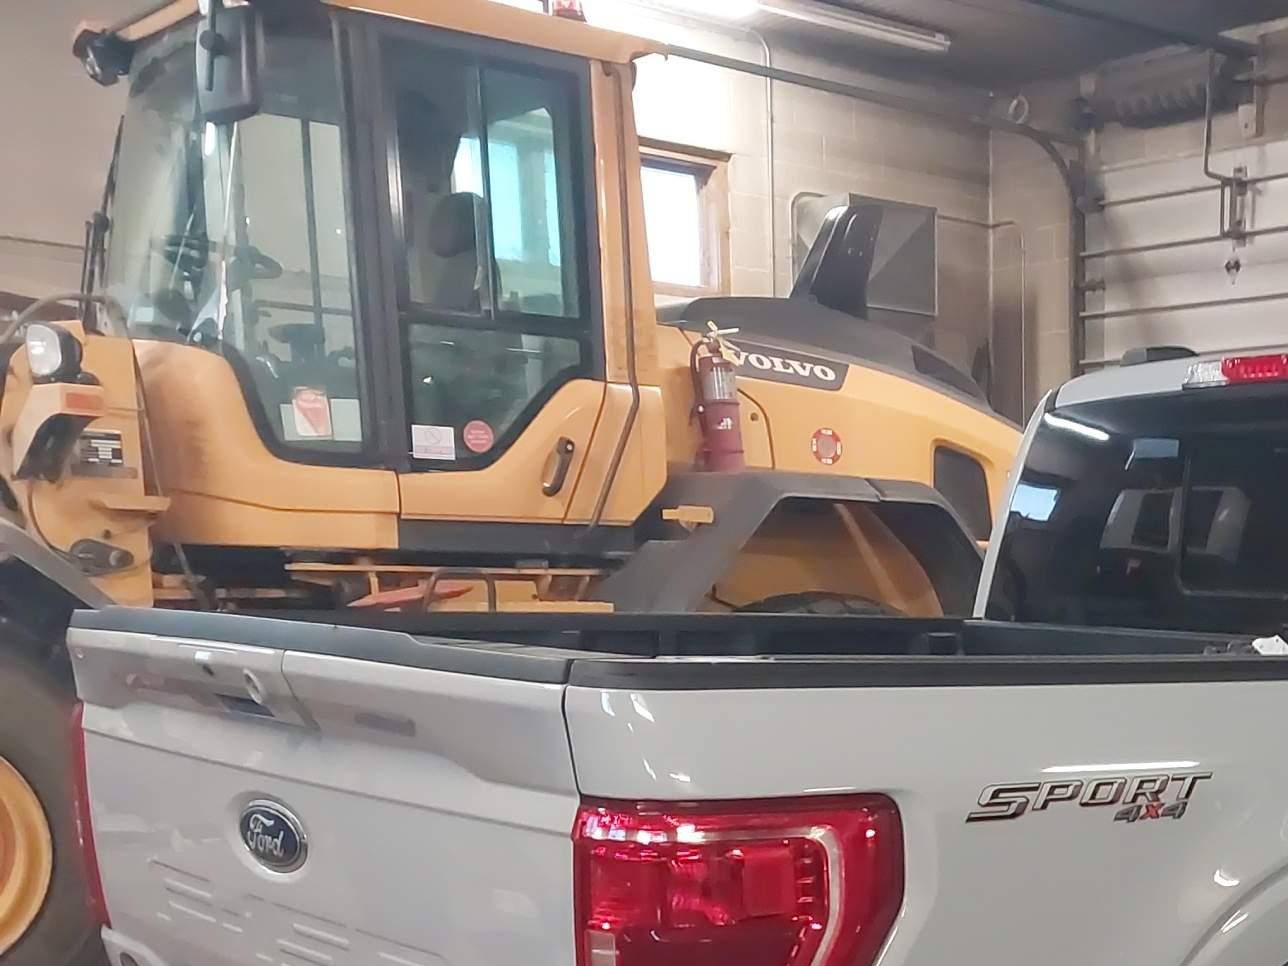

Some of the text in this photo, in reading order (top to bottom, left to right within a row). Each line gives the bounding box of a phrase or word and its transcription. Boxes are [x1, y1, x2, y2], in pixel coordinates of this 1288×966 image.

[730, 350, 836, 381] VOLVO
[965, 771, 1213, 824] SPORT
[247, 813, 285, 858] Ford
